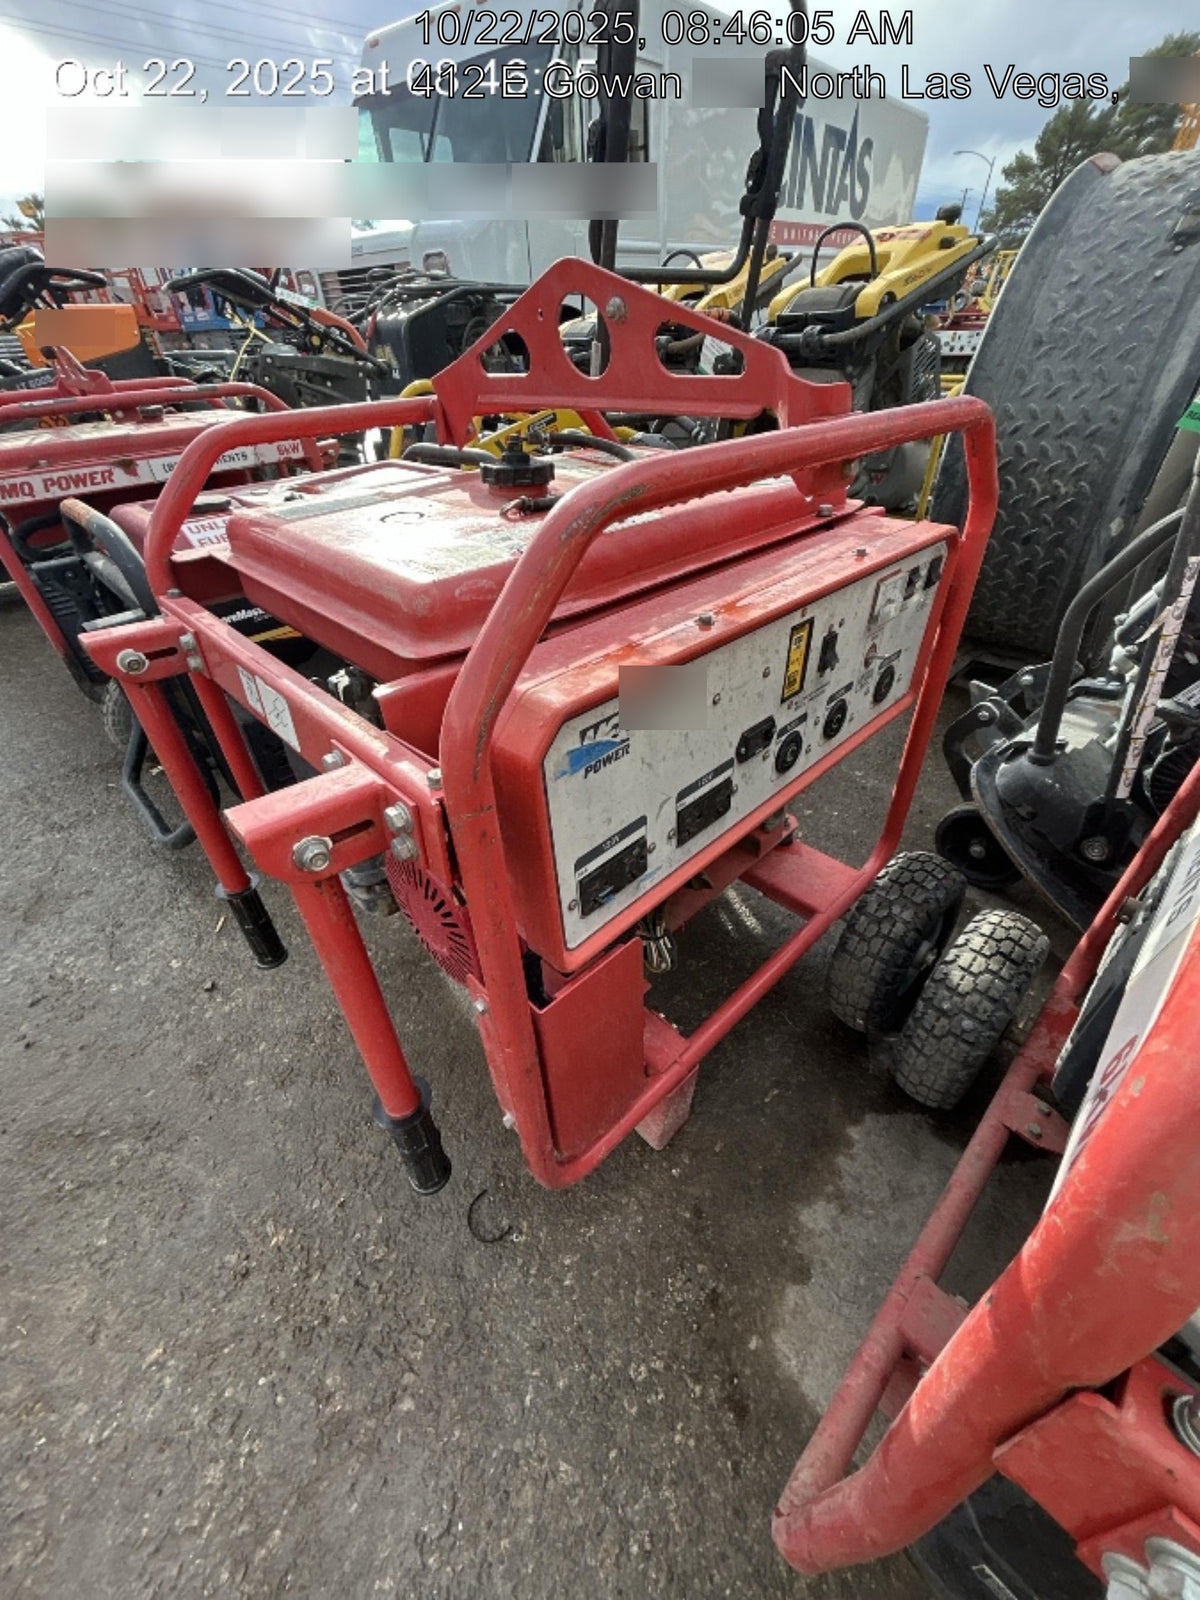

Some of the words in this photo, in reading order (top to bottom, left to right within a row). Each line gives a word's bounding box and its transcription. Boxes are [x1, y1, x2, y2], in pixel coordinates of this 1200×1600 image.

[778, 102, 874, 220] INTAS
[0, 479, 36, 500] MQ
[43, 468, 115, 494] POWER
[584, 742, 631, 779] POWER
